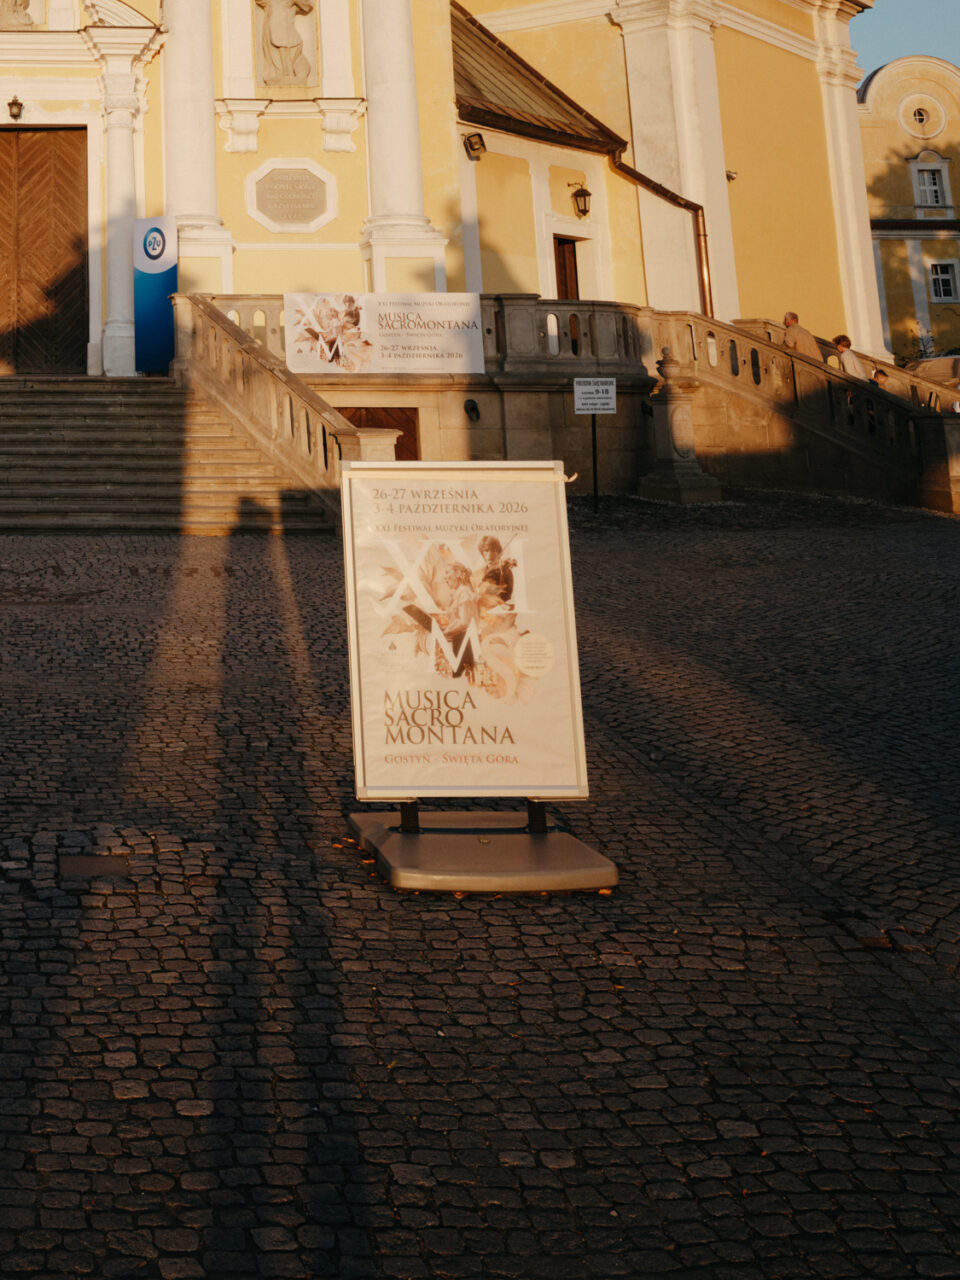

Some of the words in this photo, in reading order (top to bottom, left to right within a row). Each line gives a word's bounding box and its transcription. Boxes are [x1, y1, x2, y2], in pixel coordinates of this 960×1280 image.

[147, 236, 161, 251] PZU
[378, 312, 422, 321] MUSICA
[378, 320, 479, 330] SACROMONTANA
[372, 488, 407, 500] 26-27
[410, 488, 479, 500] WRZEŚNIA
[398, 502, 495, 514] PAŹDZIERNIKA
[499, 502, 529, 514] 2026
[383, 689, 478, 710] MUSICA
[383, 707, 465, 728] SACRO
[383, 725, 517, 745] MONTANA
[384, 752, 432, 765] GOSTYŃ
[441, 751, 483, 767] ŚWIĘTA
